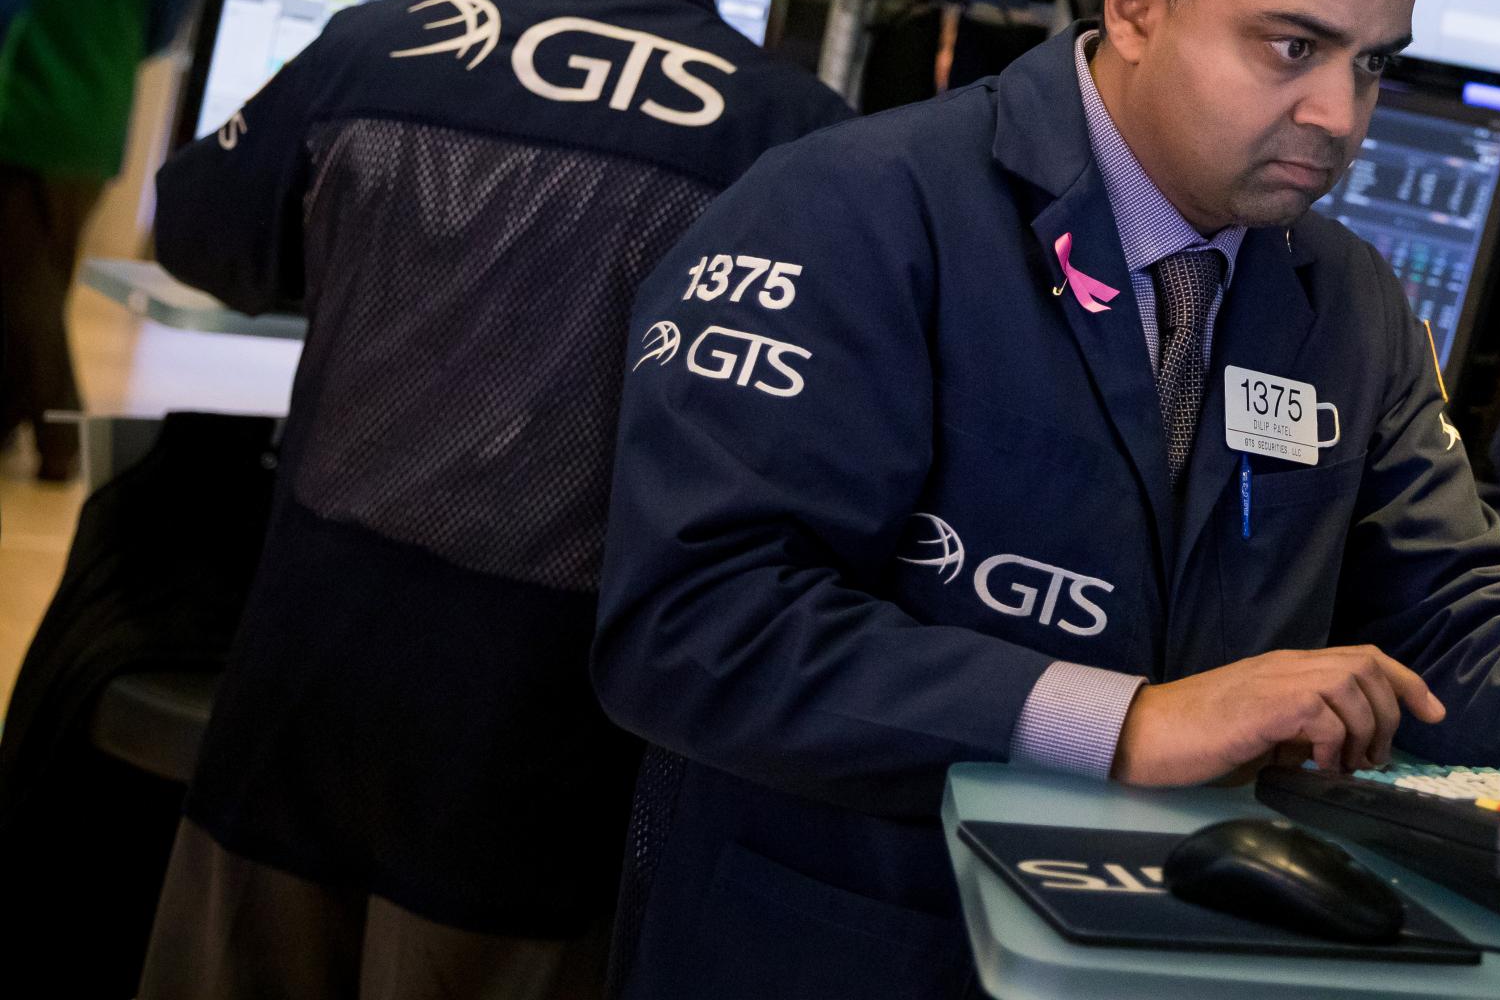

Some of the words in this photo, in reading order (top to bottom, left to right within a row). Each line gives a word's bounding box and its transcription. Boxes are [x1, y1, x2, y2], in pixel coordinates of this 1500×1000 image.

[511, 16, 738, 127] GTS
[682, 254, 803, 310] 1375
[687, 325, 813, 397] GTS
[1241, 378, 1302, 422] 1375
[1253, 419, 1270, 432] DILIP
[1273, 423, 1292, 437] PATEL
[1292, 446, 1302, 457] LLC
[973, 553, 1115, 636] GTS
[1016, 858, 1169, 893] TS
